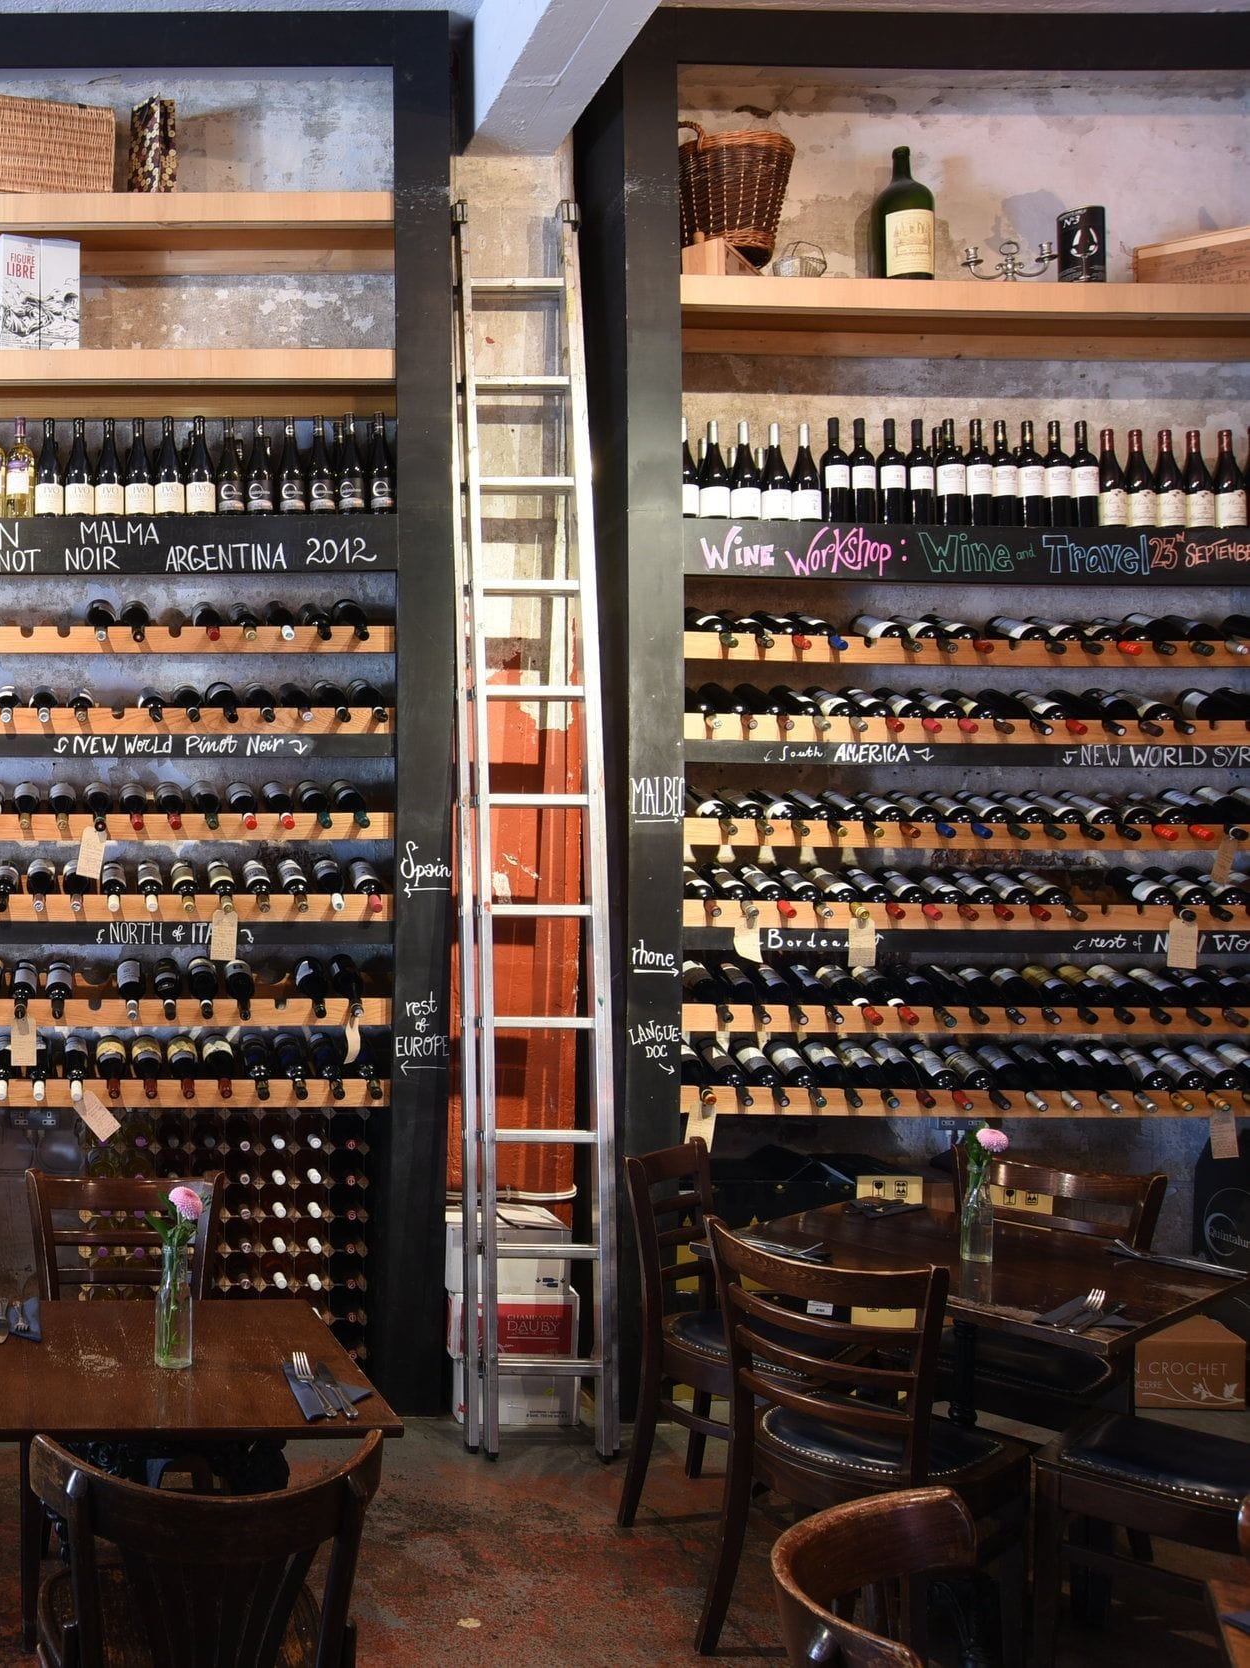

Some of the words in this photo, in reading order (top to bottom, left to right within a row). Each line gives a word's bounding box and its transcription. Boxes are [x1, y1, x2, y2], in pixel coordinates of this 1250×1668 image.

[10, 252, 36, 266] FIGURE
[6, 262, 36, 280] LIBRE
[80, 520, 160, 545] MALMA
[65, 547, 120, 571] NOIR
[165, 543, 288, 572] ARGENTINA
[306, 537, 377, 565] 2012
[918, 532, 1014, 573] Wine
[1016, 543, 1037, 561] and
[1042, 534, 1150, 576] Travel
[73, 735, 118, 755] NEW
[185, 735, 238, 756] Pinot
[246, 735, 284, 757] Noir
[778, 745, 824, 762] South
[833, 743, 910, 764] AMERICA
[1079, 744, 1121, 767] NEW
[1129, 745, 1207, 767] WORLD
[630, 776, 686, 817] MALBEC
[400, 840, 452, 887] Spain
[109, 922, 164, 945] NORTH
[172, 924, 186, 942] of
[1088, 934, 1127, 949] rest
[1132, 934, 1143, 952] of
[631, 939, 675, 967] rhone
[405, 991, 438, 1017] rest
[415, 1017, 431, 1033] of
[395, 1033, 450, 1057] EUROPE
[644, 1044, 668, 1059] DOC
[507, 1313, 561, 1321] CHAMPAGNE
[507, 1320, 561, 1332] DAUBY
[1148, 1361, 1228, 1376] CROCHET
